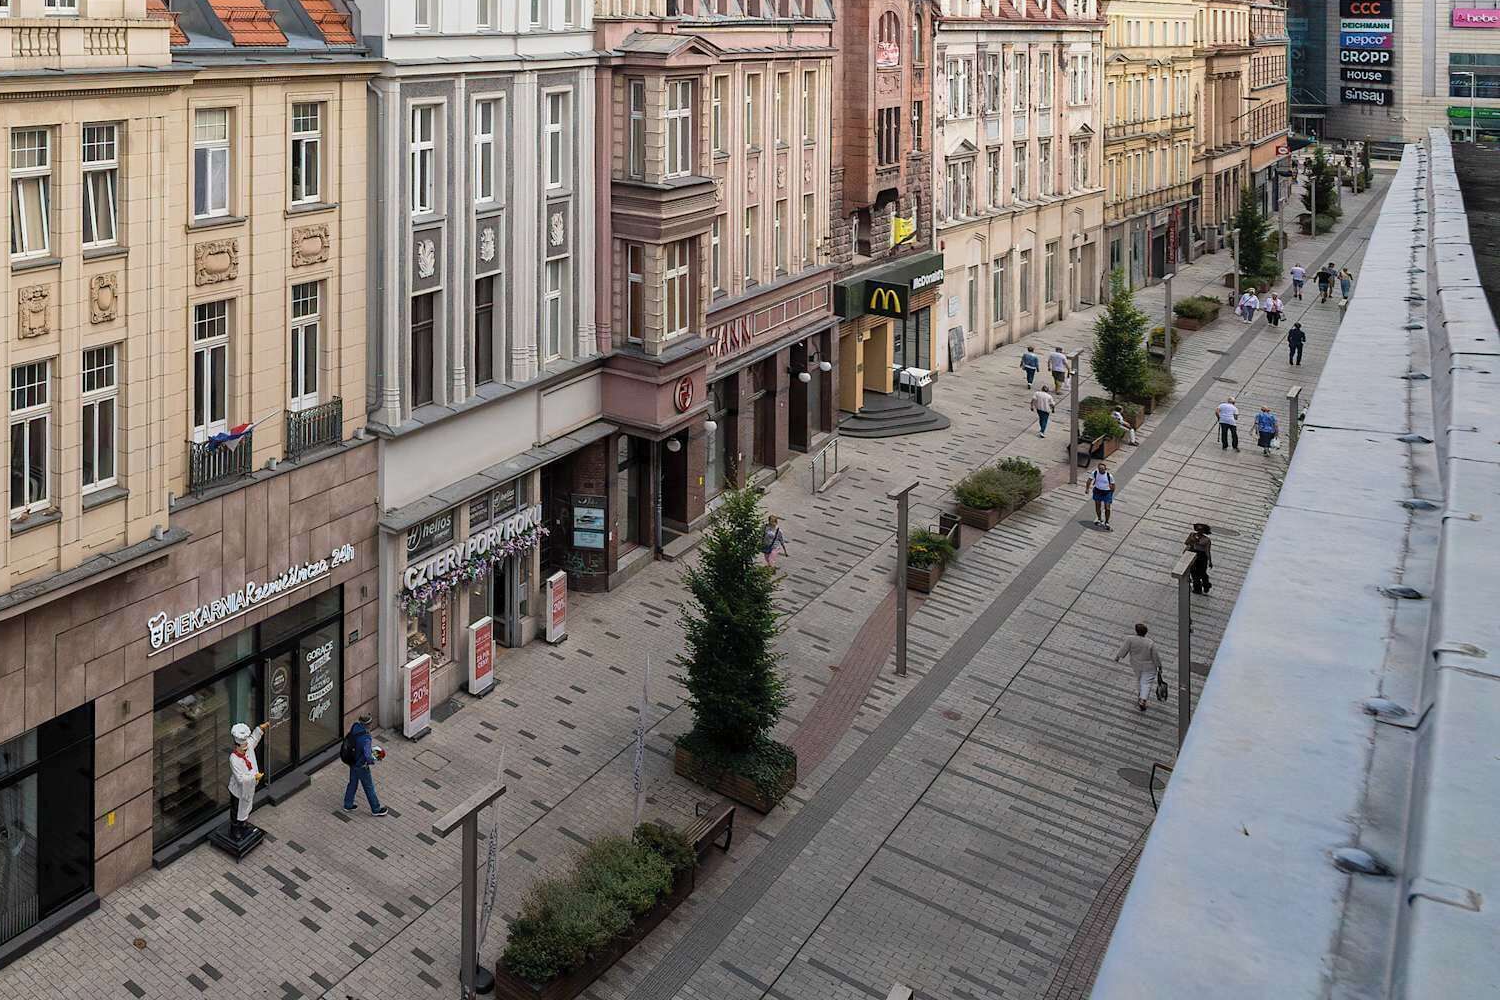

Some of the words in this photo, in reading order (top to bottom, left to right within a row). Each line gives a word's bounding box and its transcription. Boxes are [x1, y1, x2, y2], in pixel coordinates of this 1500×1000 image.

[1350, 2, 1381, 14] CCC
[1467, 13, 1499, 23] hebe
[1346, 35, 1384, 46] pepco
[1341, 50, 1390, 63] CROPP
[1345, 87, 1385, 105] sinsay
[422, 515, 452, 538] helios
[403, 542, 465, 590] CZTERY
[465, 521, 504, 560] PORY
[504, 503, 542, 541] ROKU
[164, 588, 246, 644] PIEKARNIA
[331, 543, 355, 568] 24h
